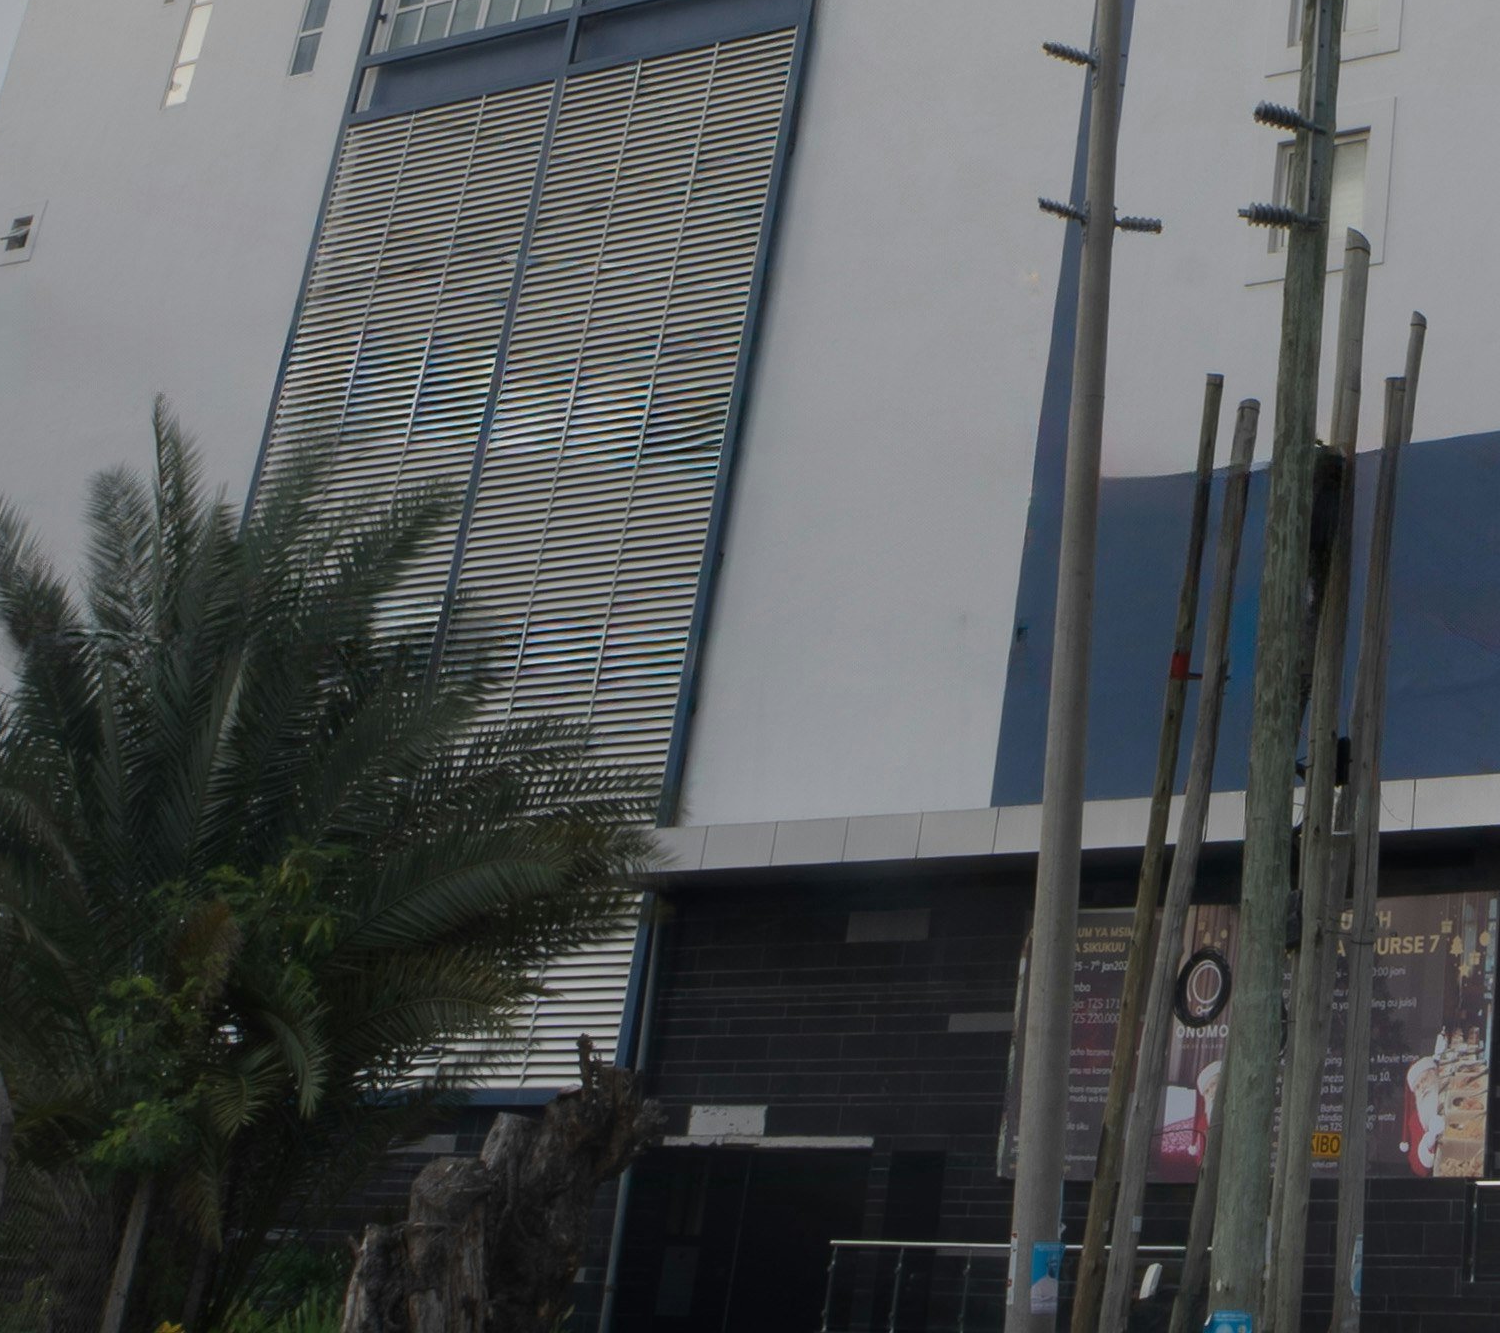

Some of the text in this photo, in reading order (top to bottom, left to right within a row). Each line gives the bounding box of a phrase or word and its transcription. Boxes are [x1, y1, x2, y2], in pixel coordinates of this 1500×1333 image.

[1373, 935, 1424, 955] URSE
[1106, 998, 1120, 1009] 171
[1176, 1024, 1229, 1039] ONOMO
